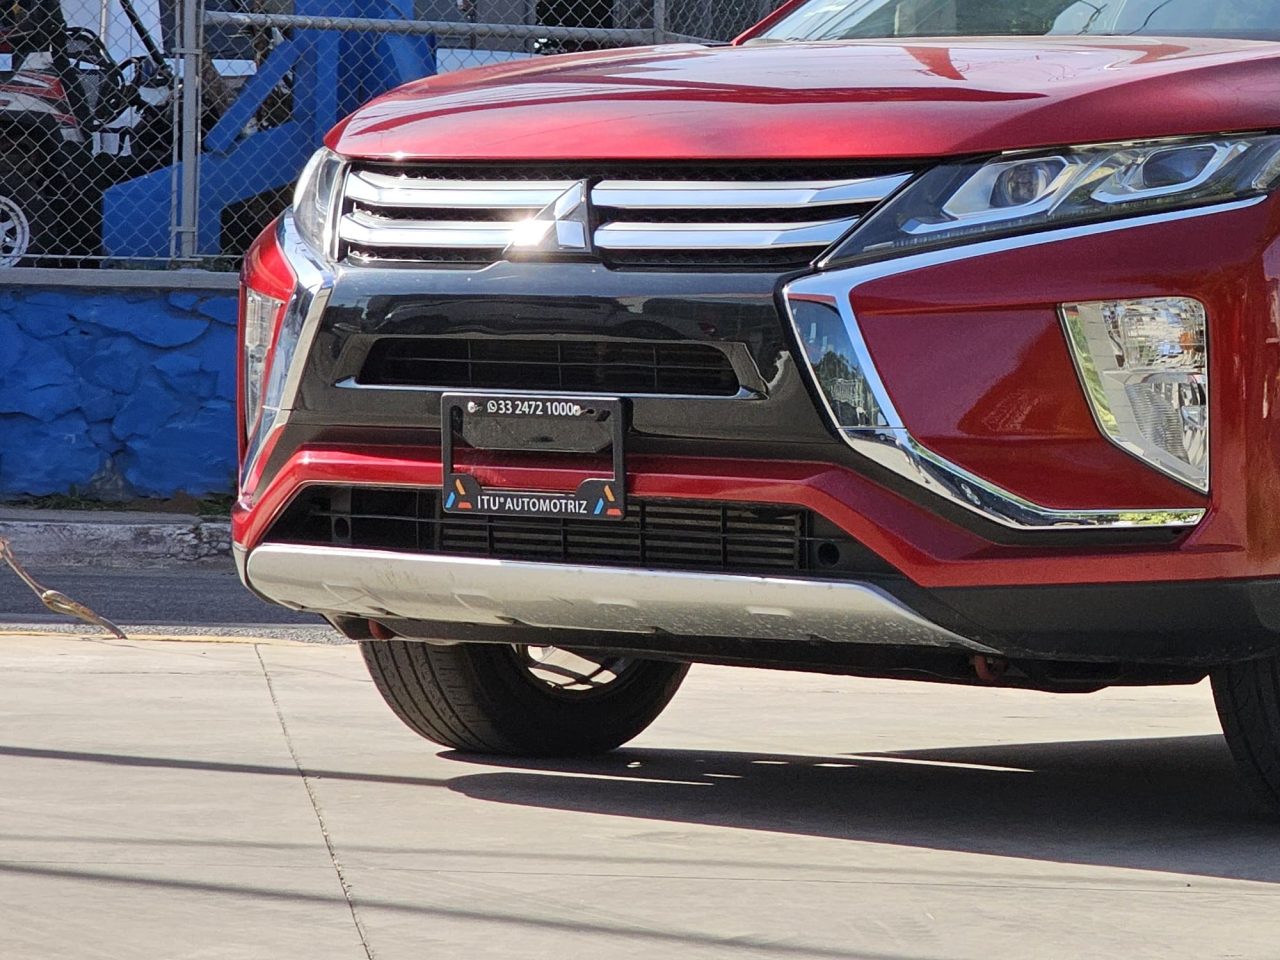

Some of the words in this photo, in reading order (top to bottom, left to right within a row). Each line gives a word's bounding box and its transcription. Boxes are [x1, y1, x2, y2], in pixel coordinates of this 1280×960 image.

[498, 400, 513, 414] 33
[514, 401, 544, 415] 2472
[546, 402, 574, 416] 1000
[505, 497, 588, 514] AUTOMOTRIZ
